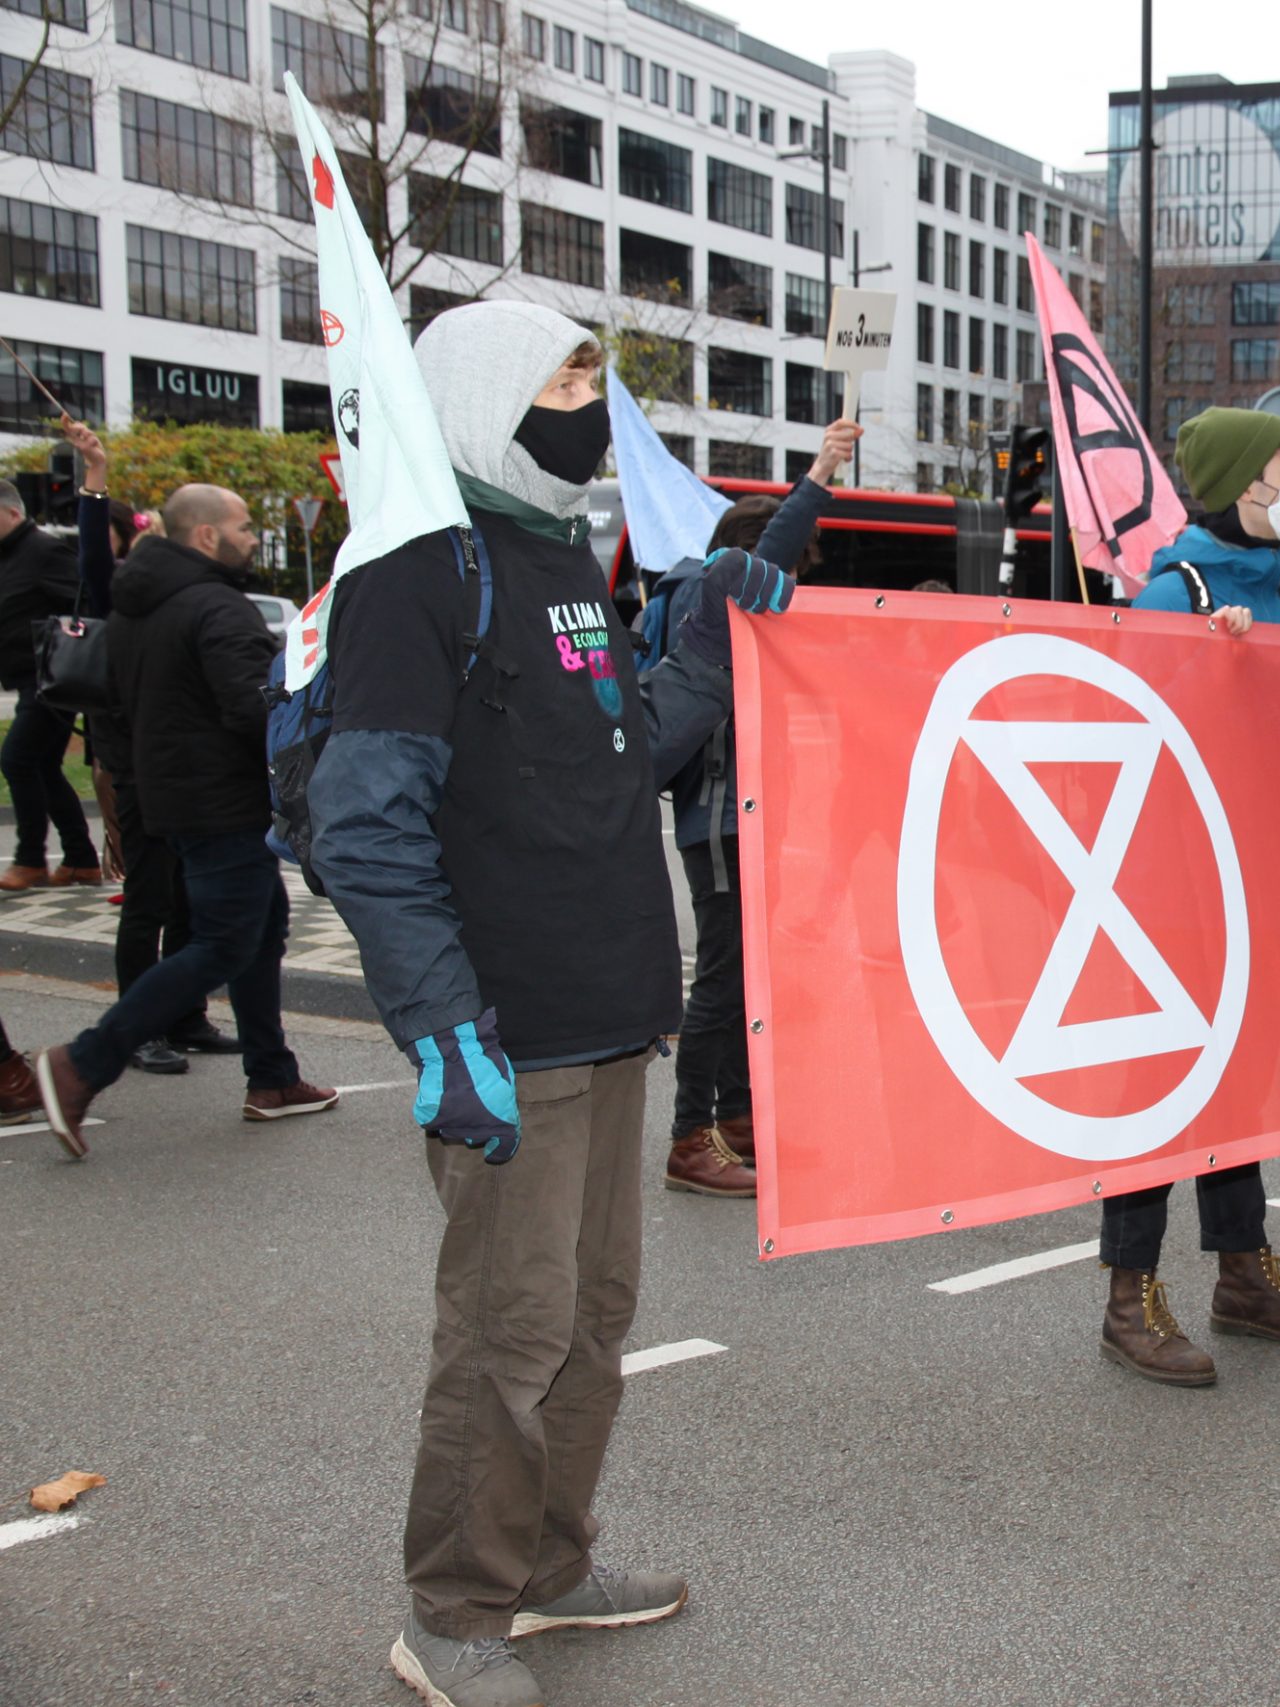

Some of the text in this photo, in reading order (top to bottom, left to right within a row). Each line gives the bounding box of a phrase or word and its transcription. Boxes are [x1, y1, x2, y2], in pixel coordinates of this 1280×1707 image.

[836, 313, 892, 348] NOG 3 MINUTEN
[157, 366, 240, 401] IGLUU
[547, 602, 607, 634] KLIMA
